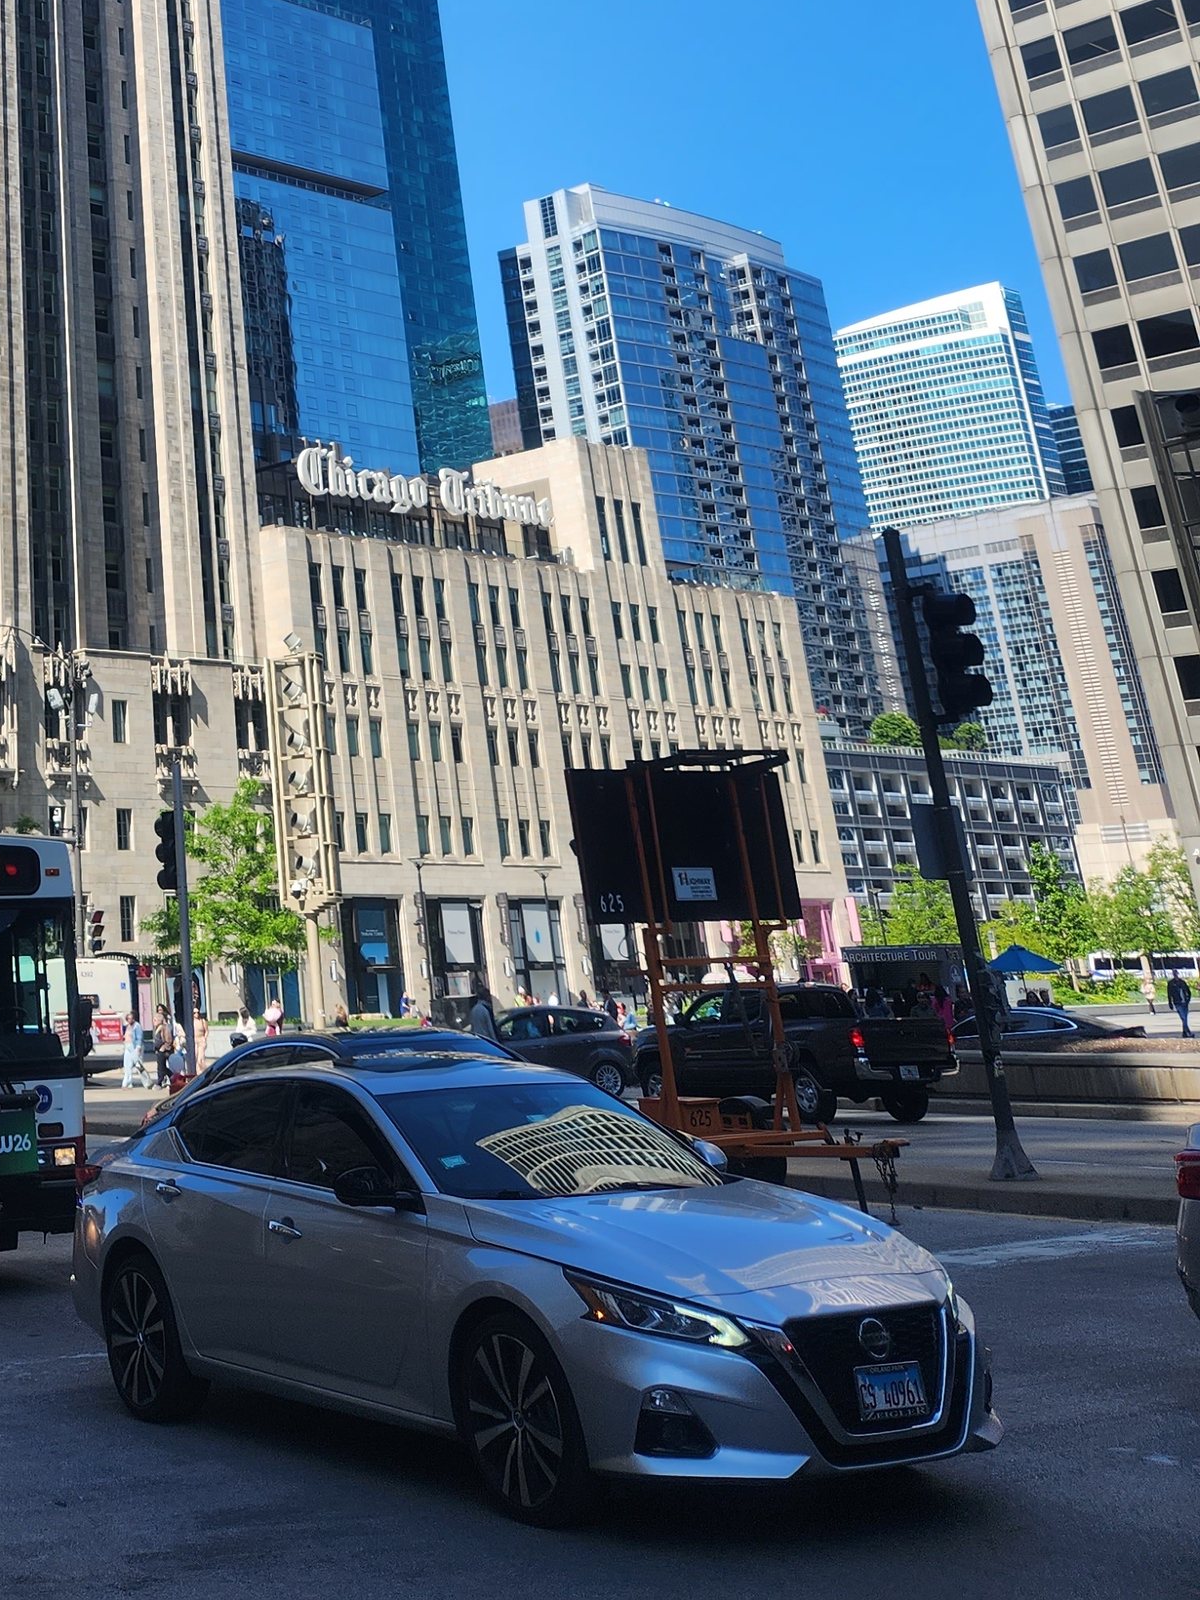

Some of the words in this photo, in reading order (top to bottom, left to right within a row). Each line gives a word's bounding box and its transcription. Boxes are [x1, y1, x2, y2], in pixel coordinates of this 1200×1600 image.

[297, 447, 429, 513] Chicago
[439, 467, 554, 528] Tribune
[600, 892, 625, 913] 625
[842, 951, 910, 962] ARCHITECTURE
[911, 949, 938, 960] TOUR
[690, 1110, 712, 1127] 625
[884, 1379, 924, 1407] 40961
[866, 1406, 926, 1420] ZEIGLER
